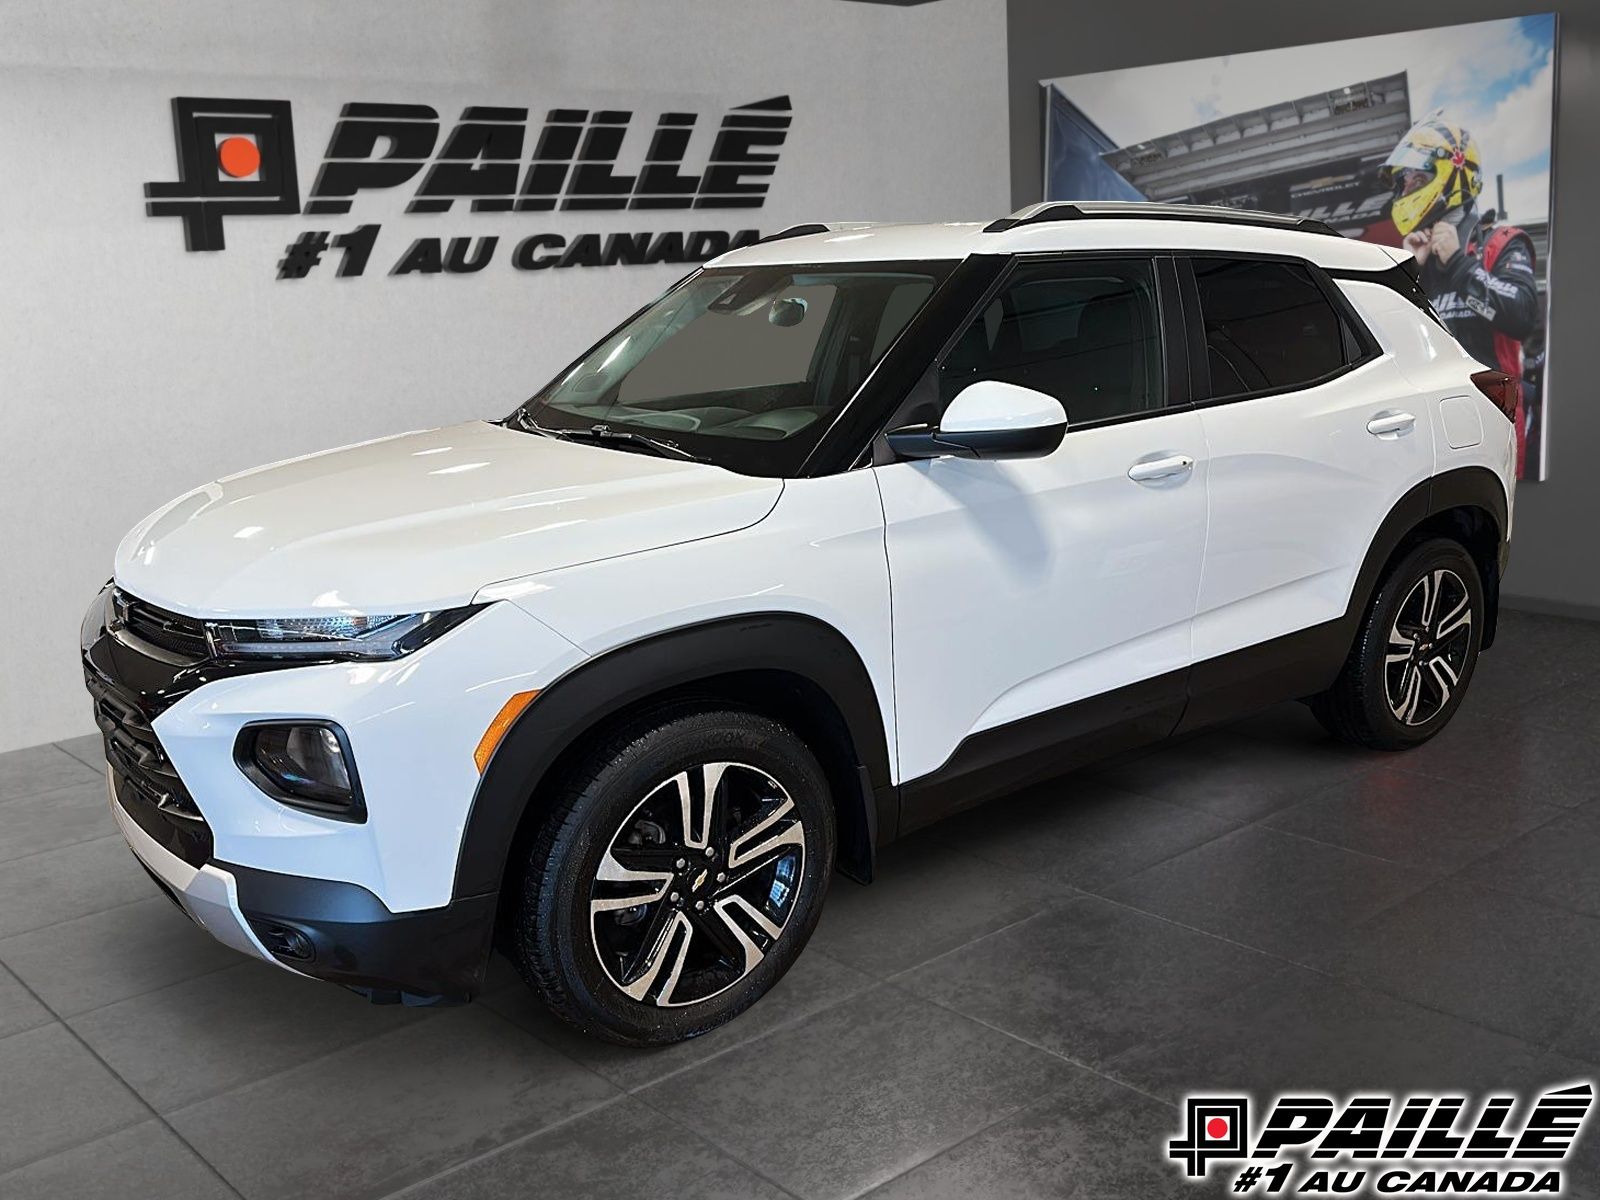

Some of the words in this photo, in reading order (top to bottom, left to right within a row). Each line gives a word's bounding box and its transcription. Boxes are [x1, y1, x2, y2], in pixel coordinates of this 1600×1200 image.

[303, 95, 792, 213] PAILLÉ
[1291, 181, 1360, 199] CHEVROLET
[1323, 210, 1381, 223] NADA
[277, 223, 381, 280] #1
[388, 235, 498, 276] AU
